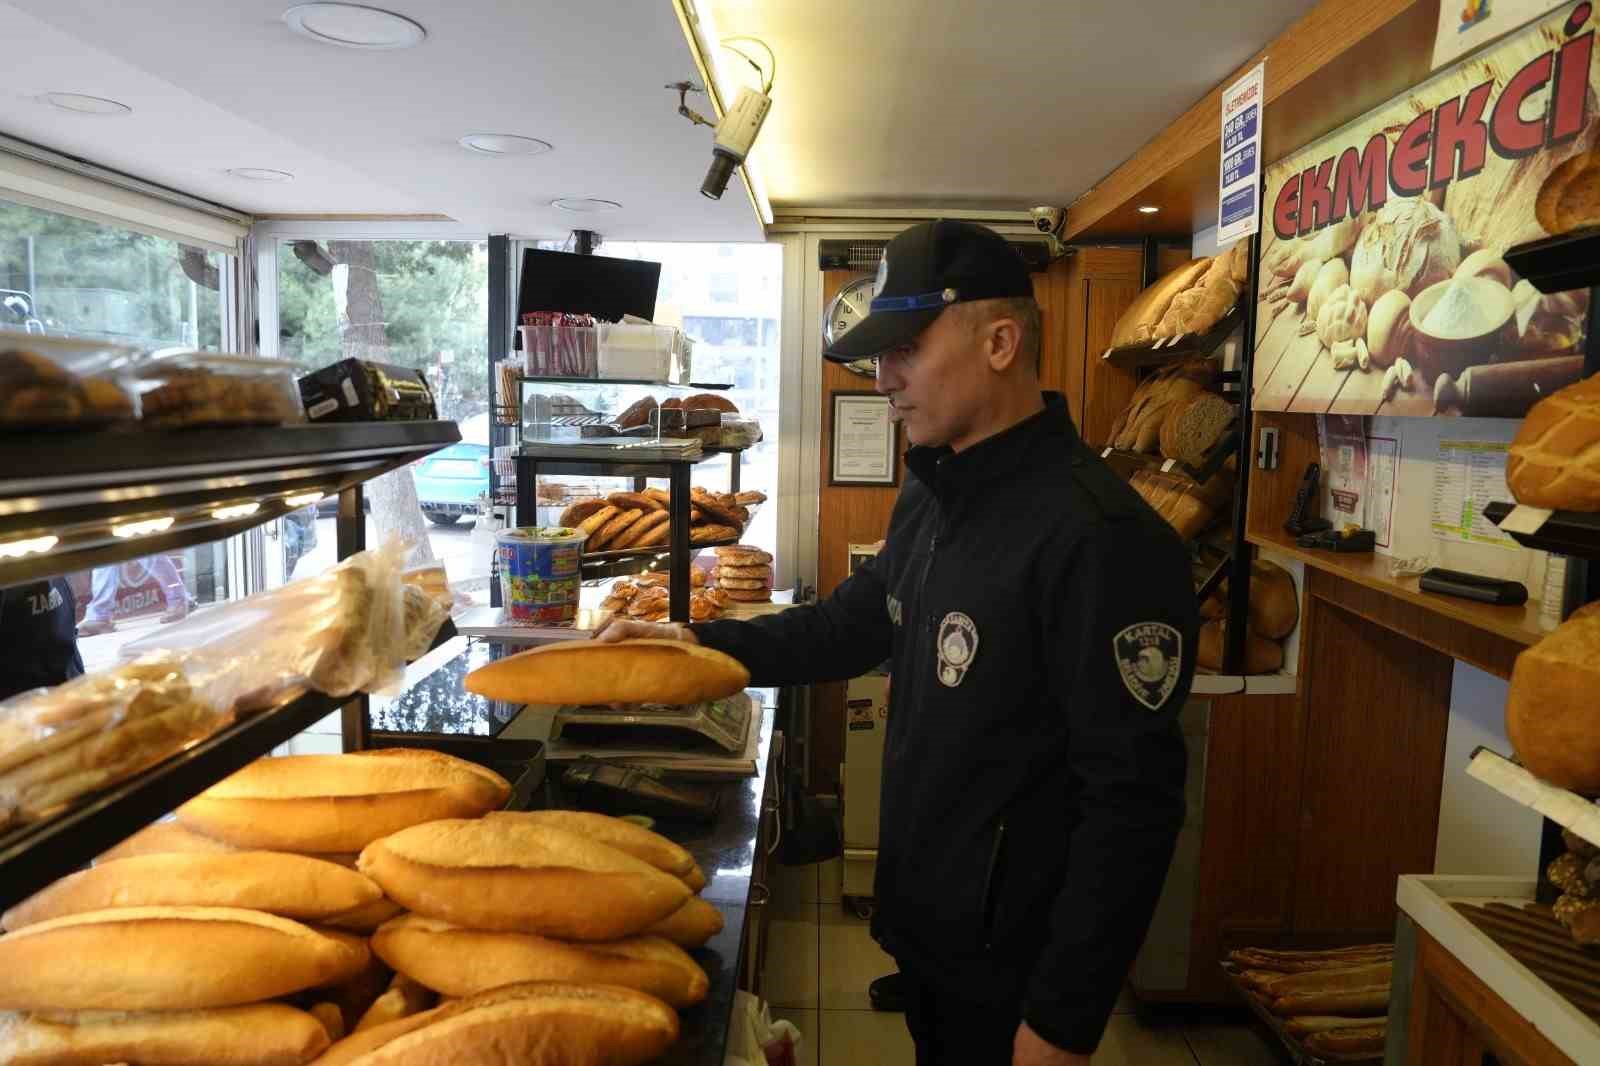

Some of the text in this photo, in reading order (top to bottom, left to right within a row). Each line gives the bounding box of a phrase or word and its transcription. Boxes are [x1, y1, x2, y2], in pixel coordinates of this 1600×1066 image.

[1273, 1, 1594, 240] EKMEKCİ
[856, 291, 863, 302] 11
[843, 304, 853, 314] 10
[838, 320, 847, 330] 9
